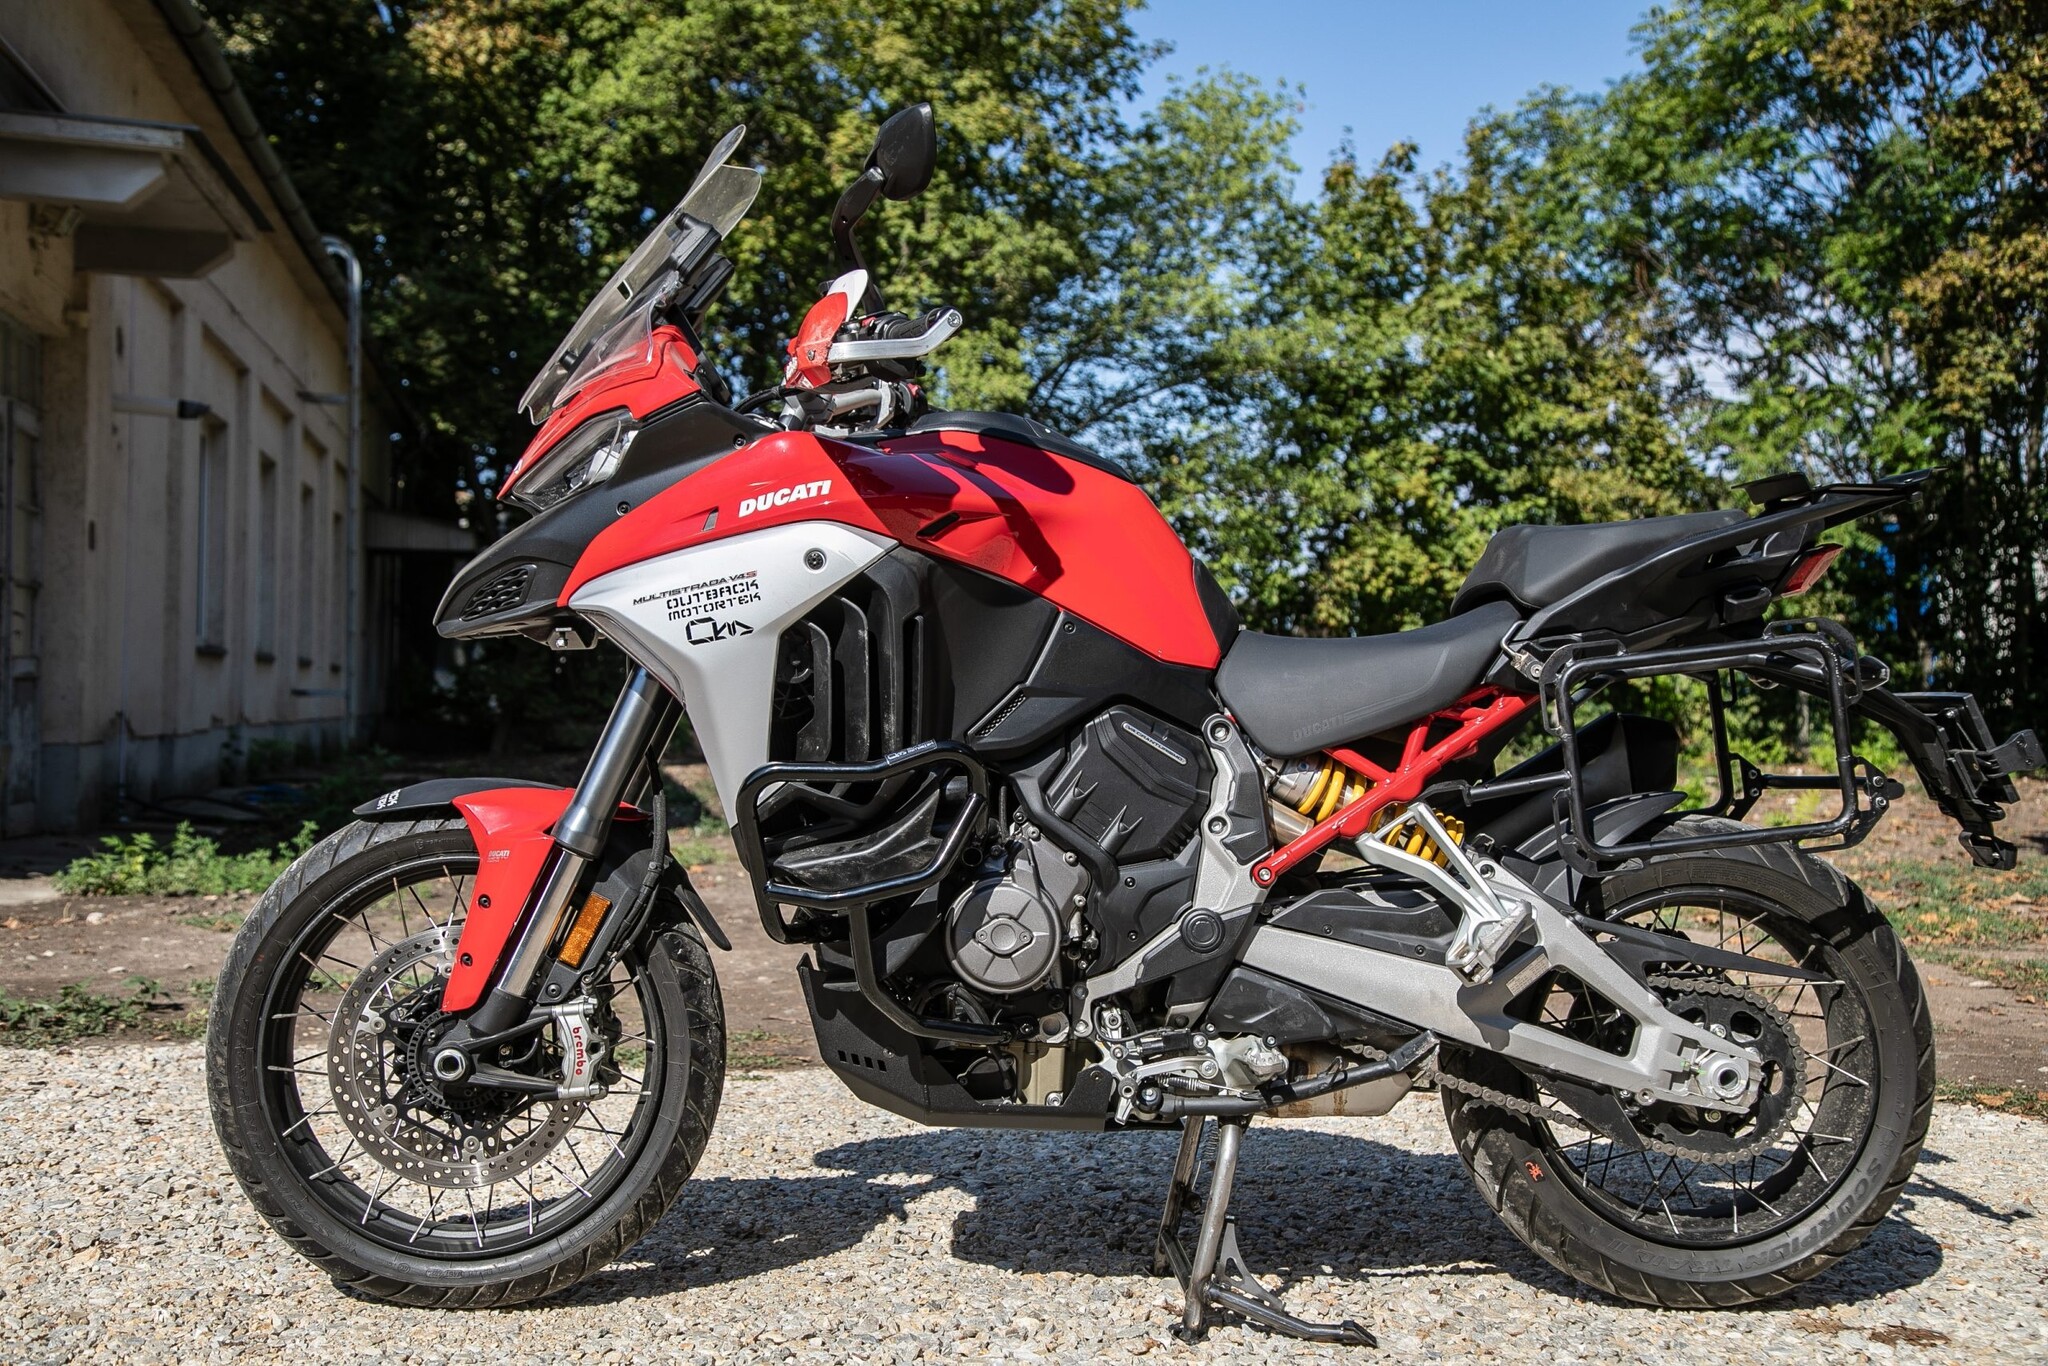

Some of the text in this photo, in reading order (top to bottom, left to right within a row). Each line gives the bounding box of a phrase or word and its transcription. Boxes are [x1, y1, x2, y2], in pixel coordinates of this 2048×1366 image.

[738, 480, 832, 518] DUCATI
[633, 577, 728, 606] MULTISTRADA
[666, 579, 760, 610] OUTBACK
[668, 592, 762, 621] MOTORTEK
[572, 1026, 587, 1076] brembo
[1746, 1157, 1883, 1270] SCORPION
